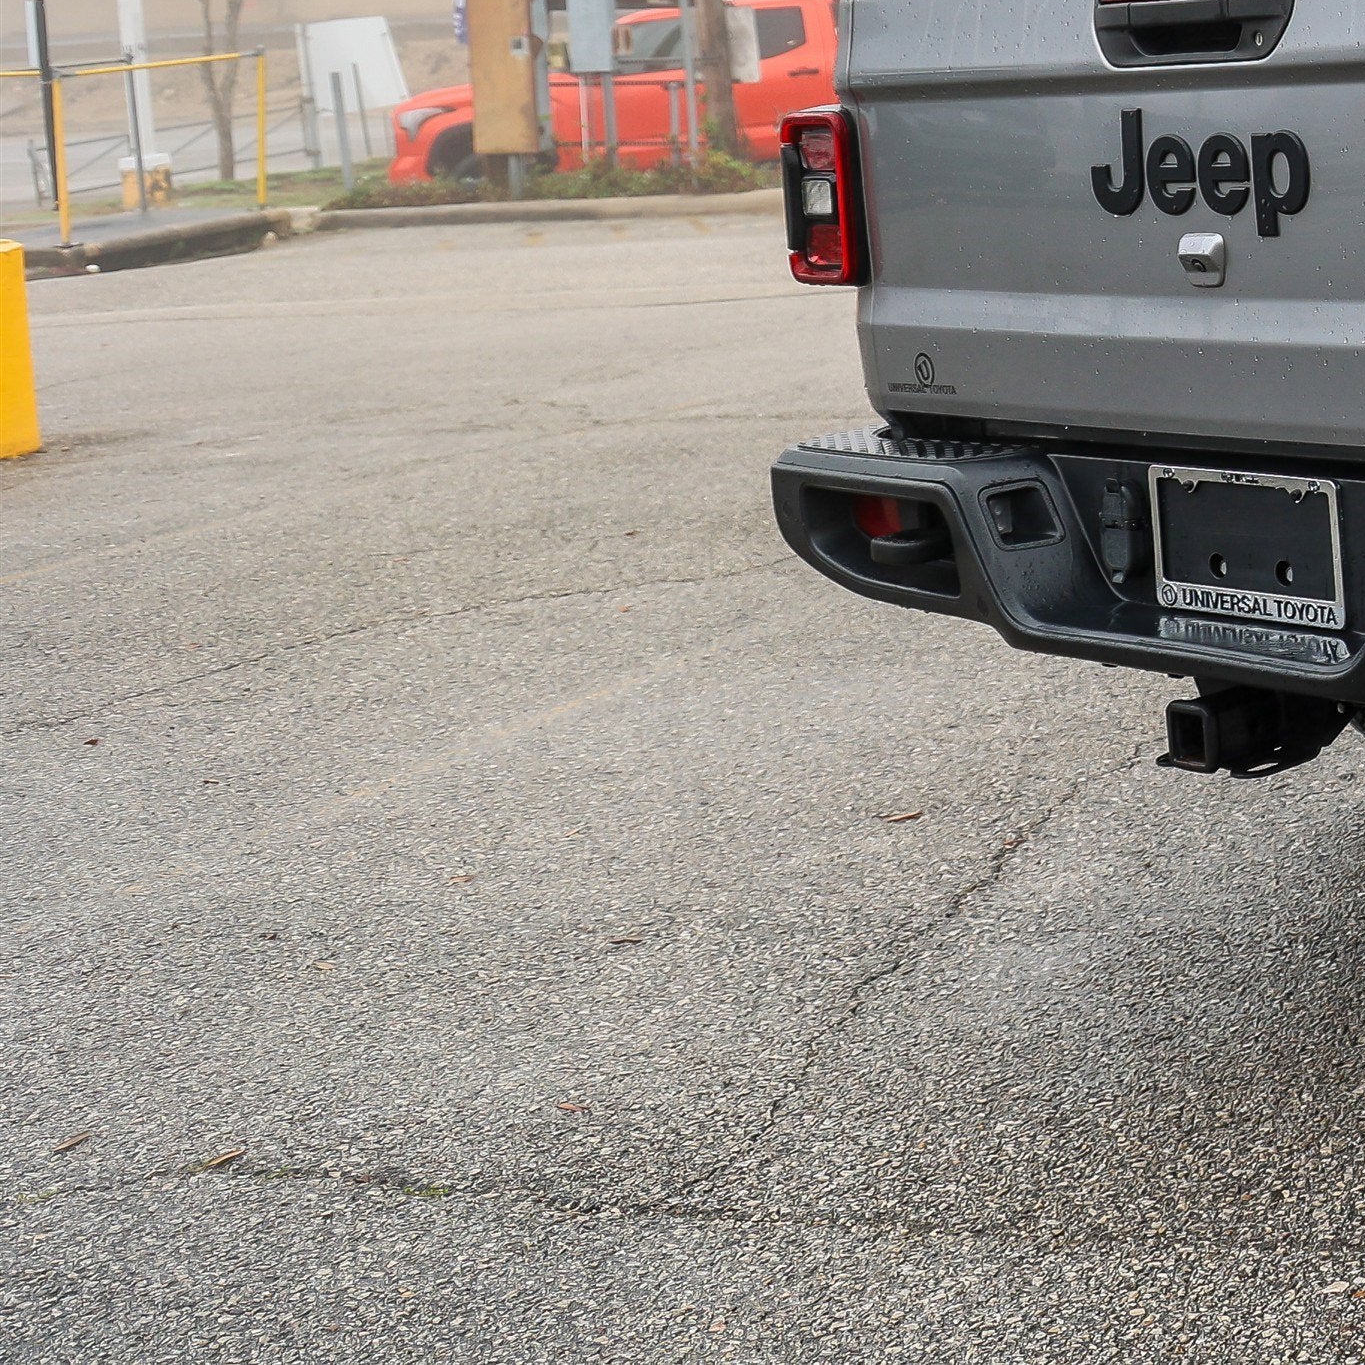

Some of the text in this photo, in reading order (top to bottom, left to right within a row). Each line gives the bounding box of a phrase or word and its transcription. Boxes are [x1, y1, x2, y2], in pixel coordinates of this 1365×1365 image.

[1091, 108, 1310, 237] Jeep
[887, 382, 957, 395] UNIVERSAL TOYOTA
[1182, 588, 1273, 617] UNIVERSAL
[1274, 599, 1339, 626] TOYOTA
